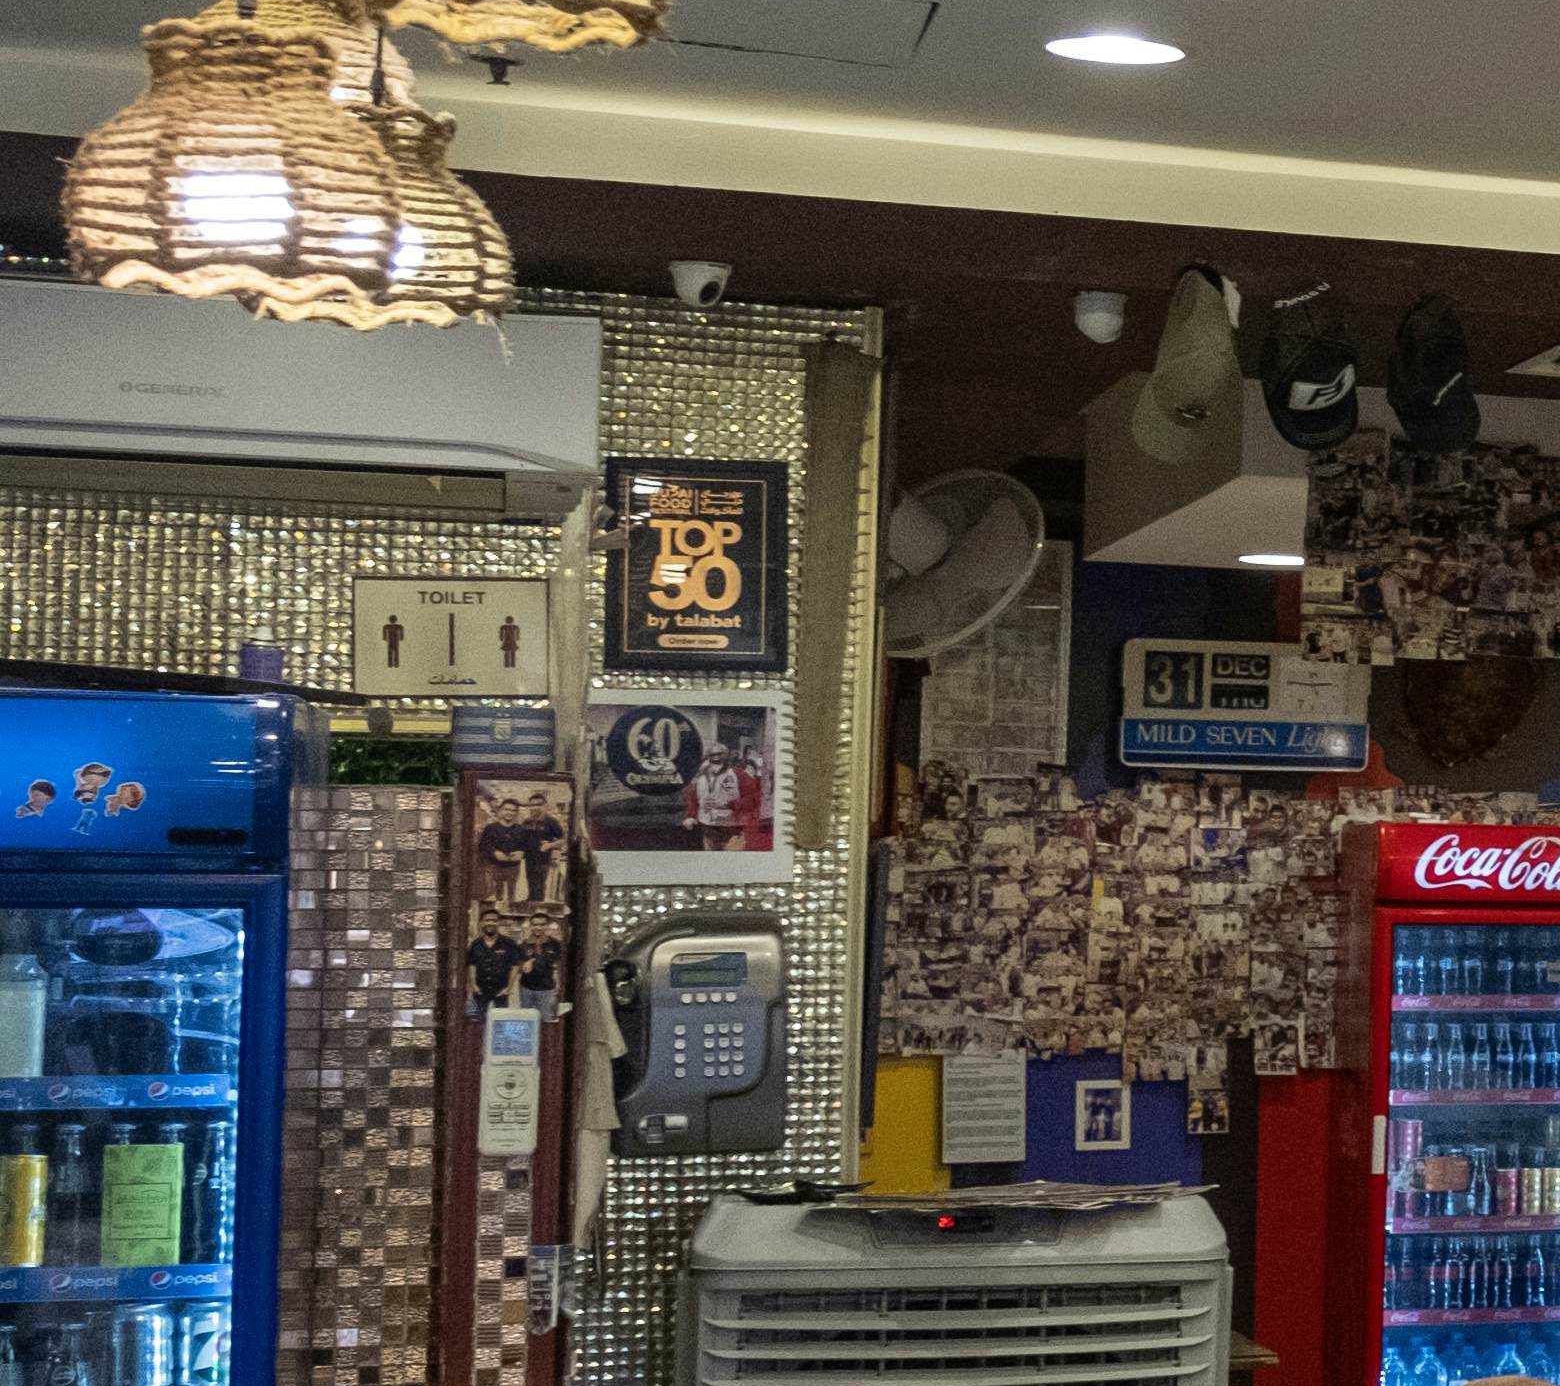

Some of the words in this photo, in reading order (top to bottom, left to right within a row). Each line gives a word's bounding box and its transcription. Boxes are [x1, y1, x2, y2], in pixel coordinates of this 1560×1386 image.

[650, 519, 744, 557] TOP
[648, 554, 743, 611] 50
[417, 590, 486, 605] TOILET
[647, 614, 670, 629] by
[675, 614, 743, 629] talabat
[1216, 655, 1268, 677] DEC
[1149, 654, 1198, 704] 31
[1136, 724, 1197, 744] MILD
[1206, 725, 1277, 747] SEVEN
[172, 1083, 216, 1099] pepsi
[73, 1274, 119, 1290] pepsi
[174, 1271, 219, 1288] pepsi
